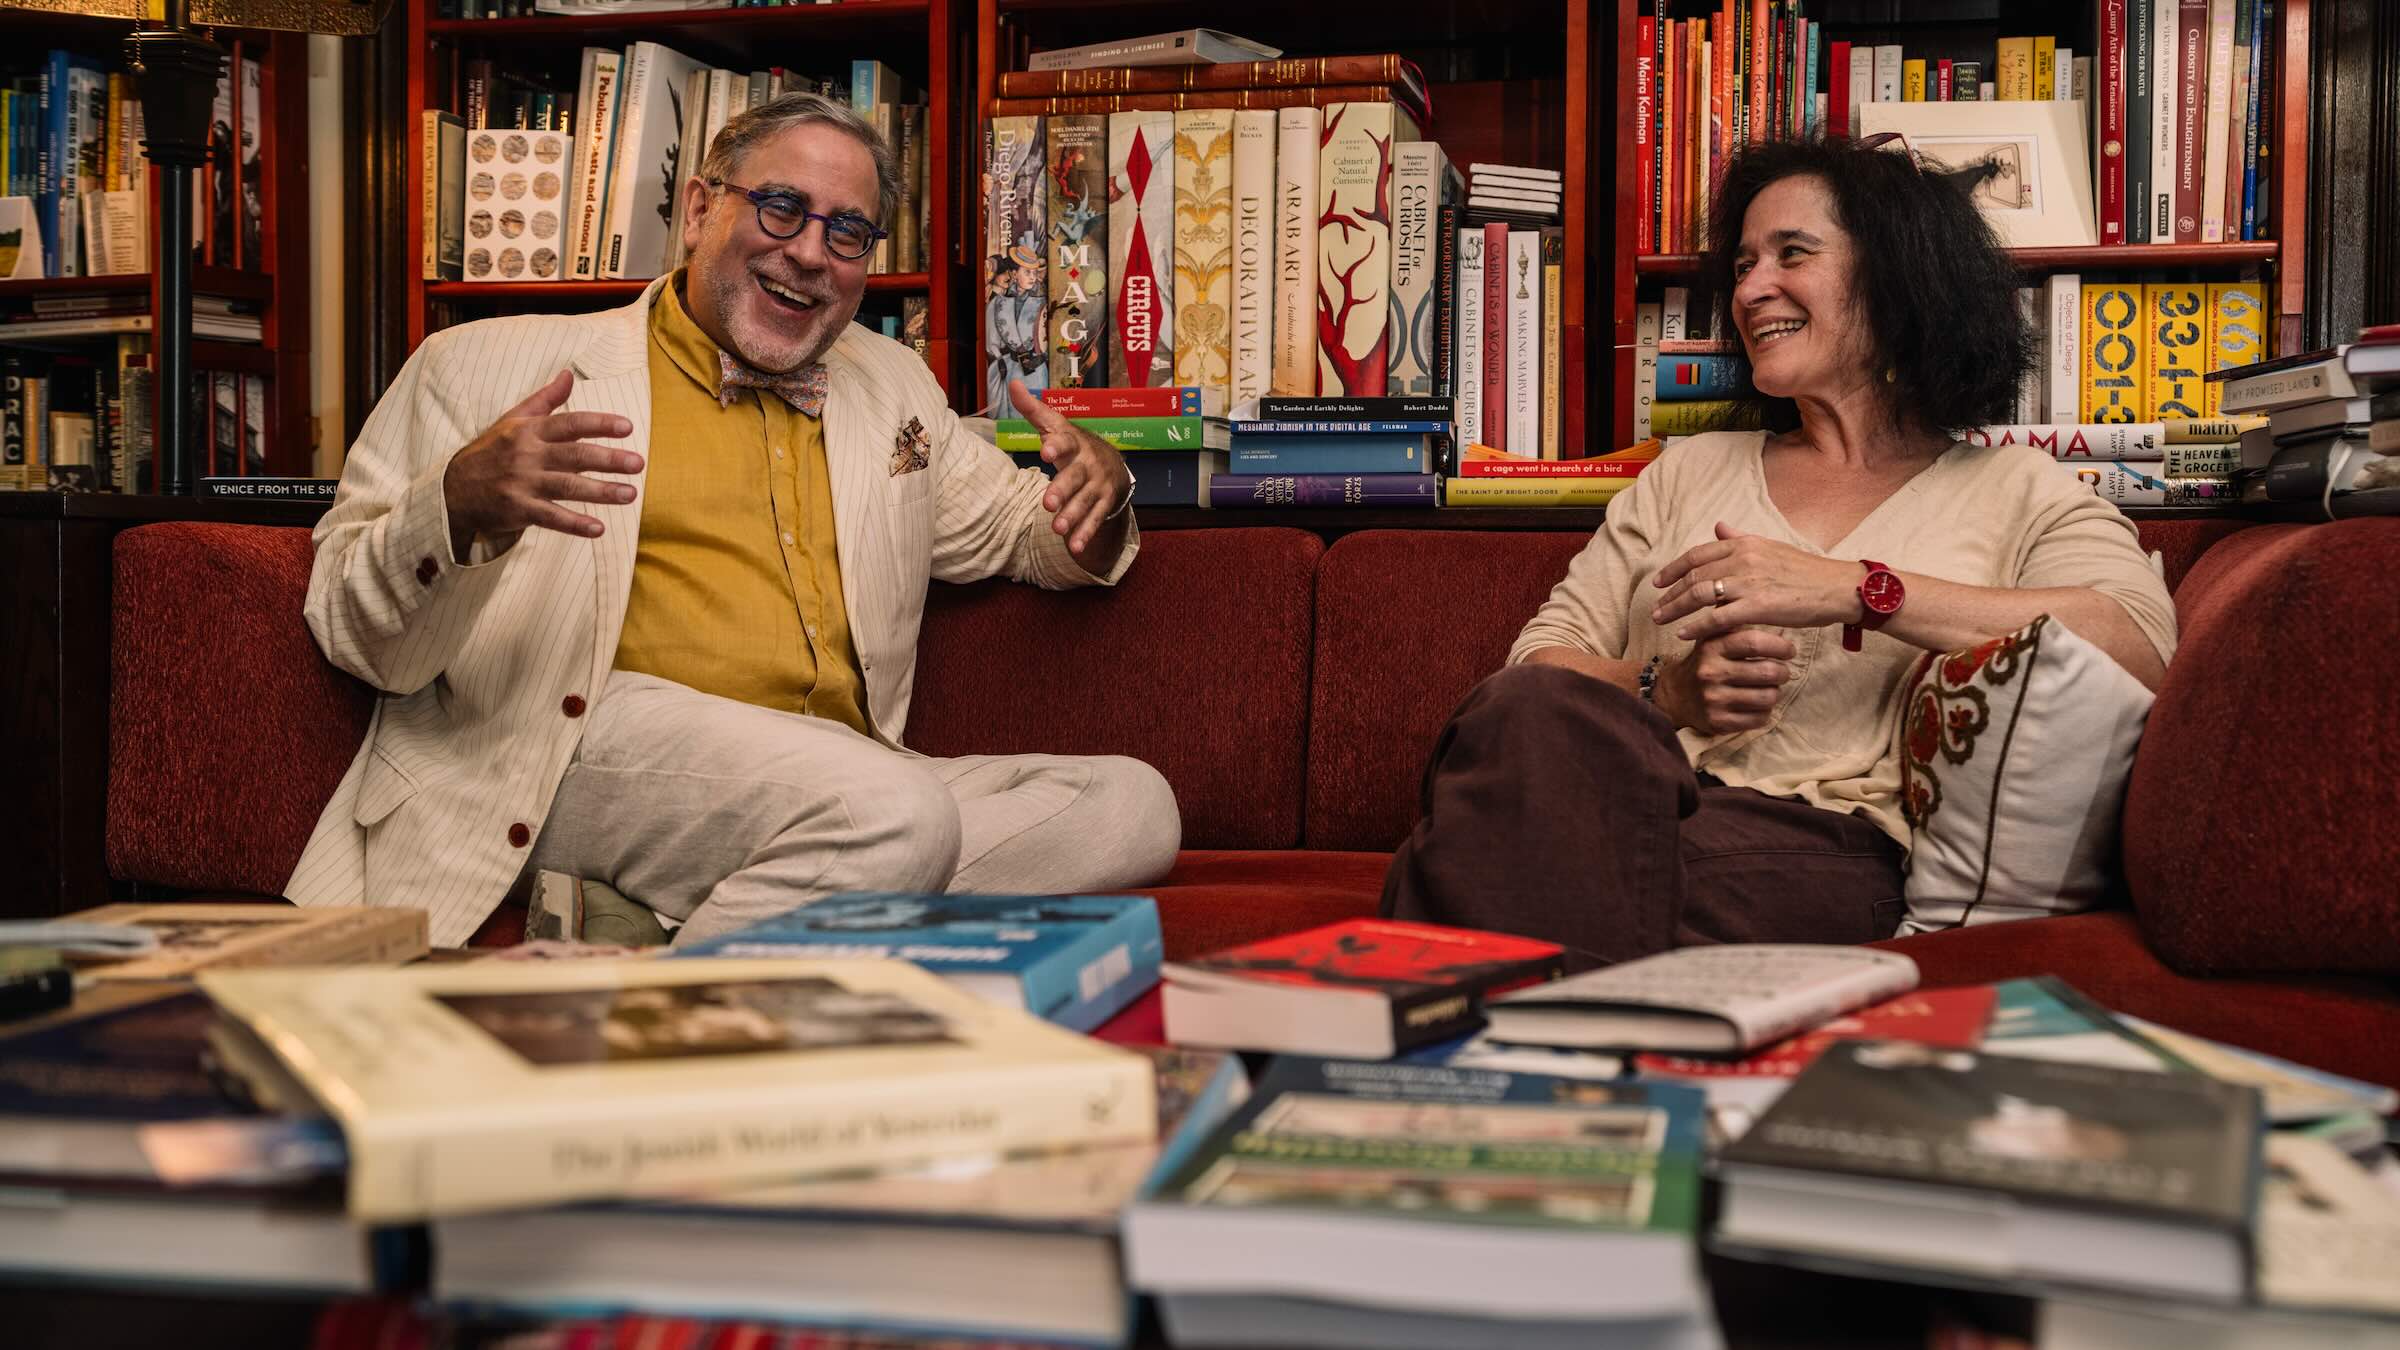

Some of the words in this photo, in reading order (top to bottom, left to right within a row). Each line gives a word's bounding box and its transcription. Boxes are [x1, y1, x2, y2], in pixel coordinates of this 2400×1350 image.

[2139, 4, 2147, 55] ENTDECKUNG
[1091, 48, 1121, 59] FINDING
[1131, 42, 1165, 53] LIKENESS
[2110, 36, 2119, 53] Arts
[2185, 28, 2200, 81] CURIOSITY
[2110, 55, 2119, 65] of
[2110, 65, 2119, 79] the
[2138, 56, 2146, 71] DER
[1638, 57, 1651, 92] Maira
[2138, 72, 2146, 97] NATUR
[2109, 81, 2119, 130] Renaissance
[2186, 85, 2195, 104] AND
[426, 119, 435, 140] THE
[1636, 94, 1650, 145] Kalman
[67, 146, 77, 159] GO
[993, 130, 1017, 188] Diego
[2182, 107, 2197, 191] ENLIGHTENMENT
[67, 162, 76, 175] TO
[1338, 166, 1368, 175] Natural
[587, 176, 599, 203] and
[999, 190, 1017, 247] Rivera
[1286, 181, 1303, 240] ARAB
[1412, 185, 1428, 257] CABINET
[580, 202, 596, 254] demons
[1397, 185, 1414, 287] CURIOSITIES
[1284, 245, 1301, 287] ART
[1412, 256, 1421, 269] OF
[1441, 210, 1454, 303] EXTRAORDINARY
[1238, 197, 1260, 362] DECORATIVE
[1487, 242, 1500, 309] CABINETS
[1059, 244, 1091, 378] MAGI
[1126, 275, 1151, 352] CIRCUS
[1465, 287, 1478, 359] CABINETS
[2064, 294, 2075, 330] Objects
[1439, 306, 1452, 380] EXHIBITIONS
[1517, 309, 1528, 357] MAKING
[2064, 331, 2074, 343] of
[1486, 329, 1500, 386] WONDER
[2062, 344, 2074, 377] Design
[1238, 366, 1257, 400] AR
[1516, 360, 1528, 413] MARVELS
[2245, 383, 2286, 399] PROMISED
[2287, 378, 2313, 393] LAND
[1047, 397, 1058, 405] The
[1058, 397, 1073, 405] Duff
[1069, 404, 1091, 412] Diaries
[1315, 405, 1338, 413] Earthly
[1339, 405, 1365, 413] Delights
[6, 376, 21, 461] DRAC
[1238, 422, 1274, 432] MESSIANIC
[1275, 422, 1304, 432] ZIONISM
[1306, 422, 1314, 431] IN
[1315, 422, 1328, 431] THE
[1330, 422, 1357, 431] DIGITAL
[1358, 422, 1372, 431] AGE
[2188, 421, 2240, 436] matrix
[1123, 430, 1144, 439] Bricks
[2110, 432, 2119, 454] LAVIE
[2118, 427, 2127, 457] TIDHAR
[1492, 466, 1514, 475] cage
[1516, 465, 1540, 473] went
[1541, 464, 1549, 473] in
[1552, 464, 1581, 473] search
[1583, 464, 1594, 473] of
[1604, 463, 1623, 472] bird
[2170, 449, 2181, 474] THE
[212, 484, 255, 495] VENICE
[257, 484, 290, 495] FROM
[292, 484, 316, 495] THE
[1254, 480, 1265, 499] INK
[1344, 477, 1353, 504] EMMA
[2108, 471, 2116, 495] LAVIE
